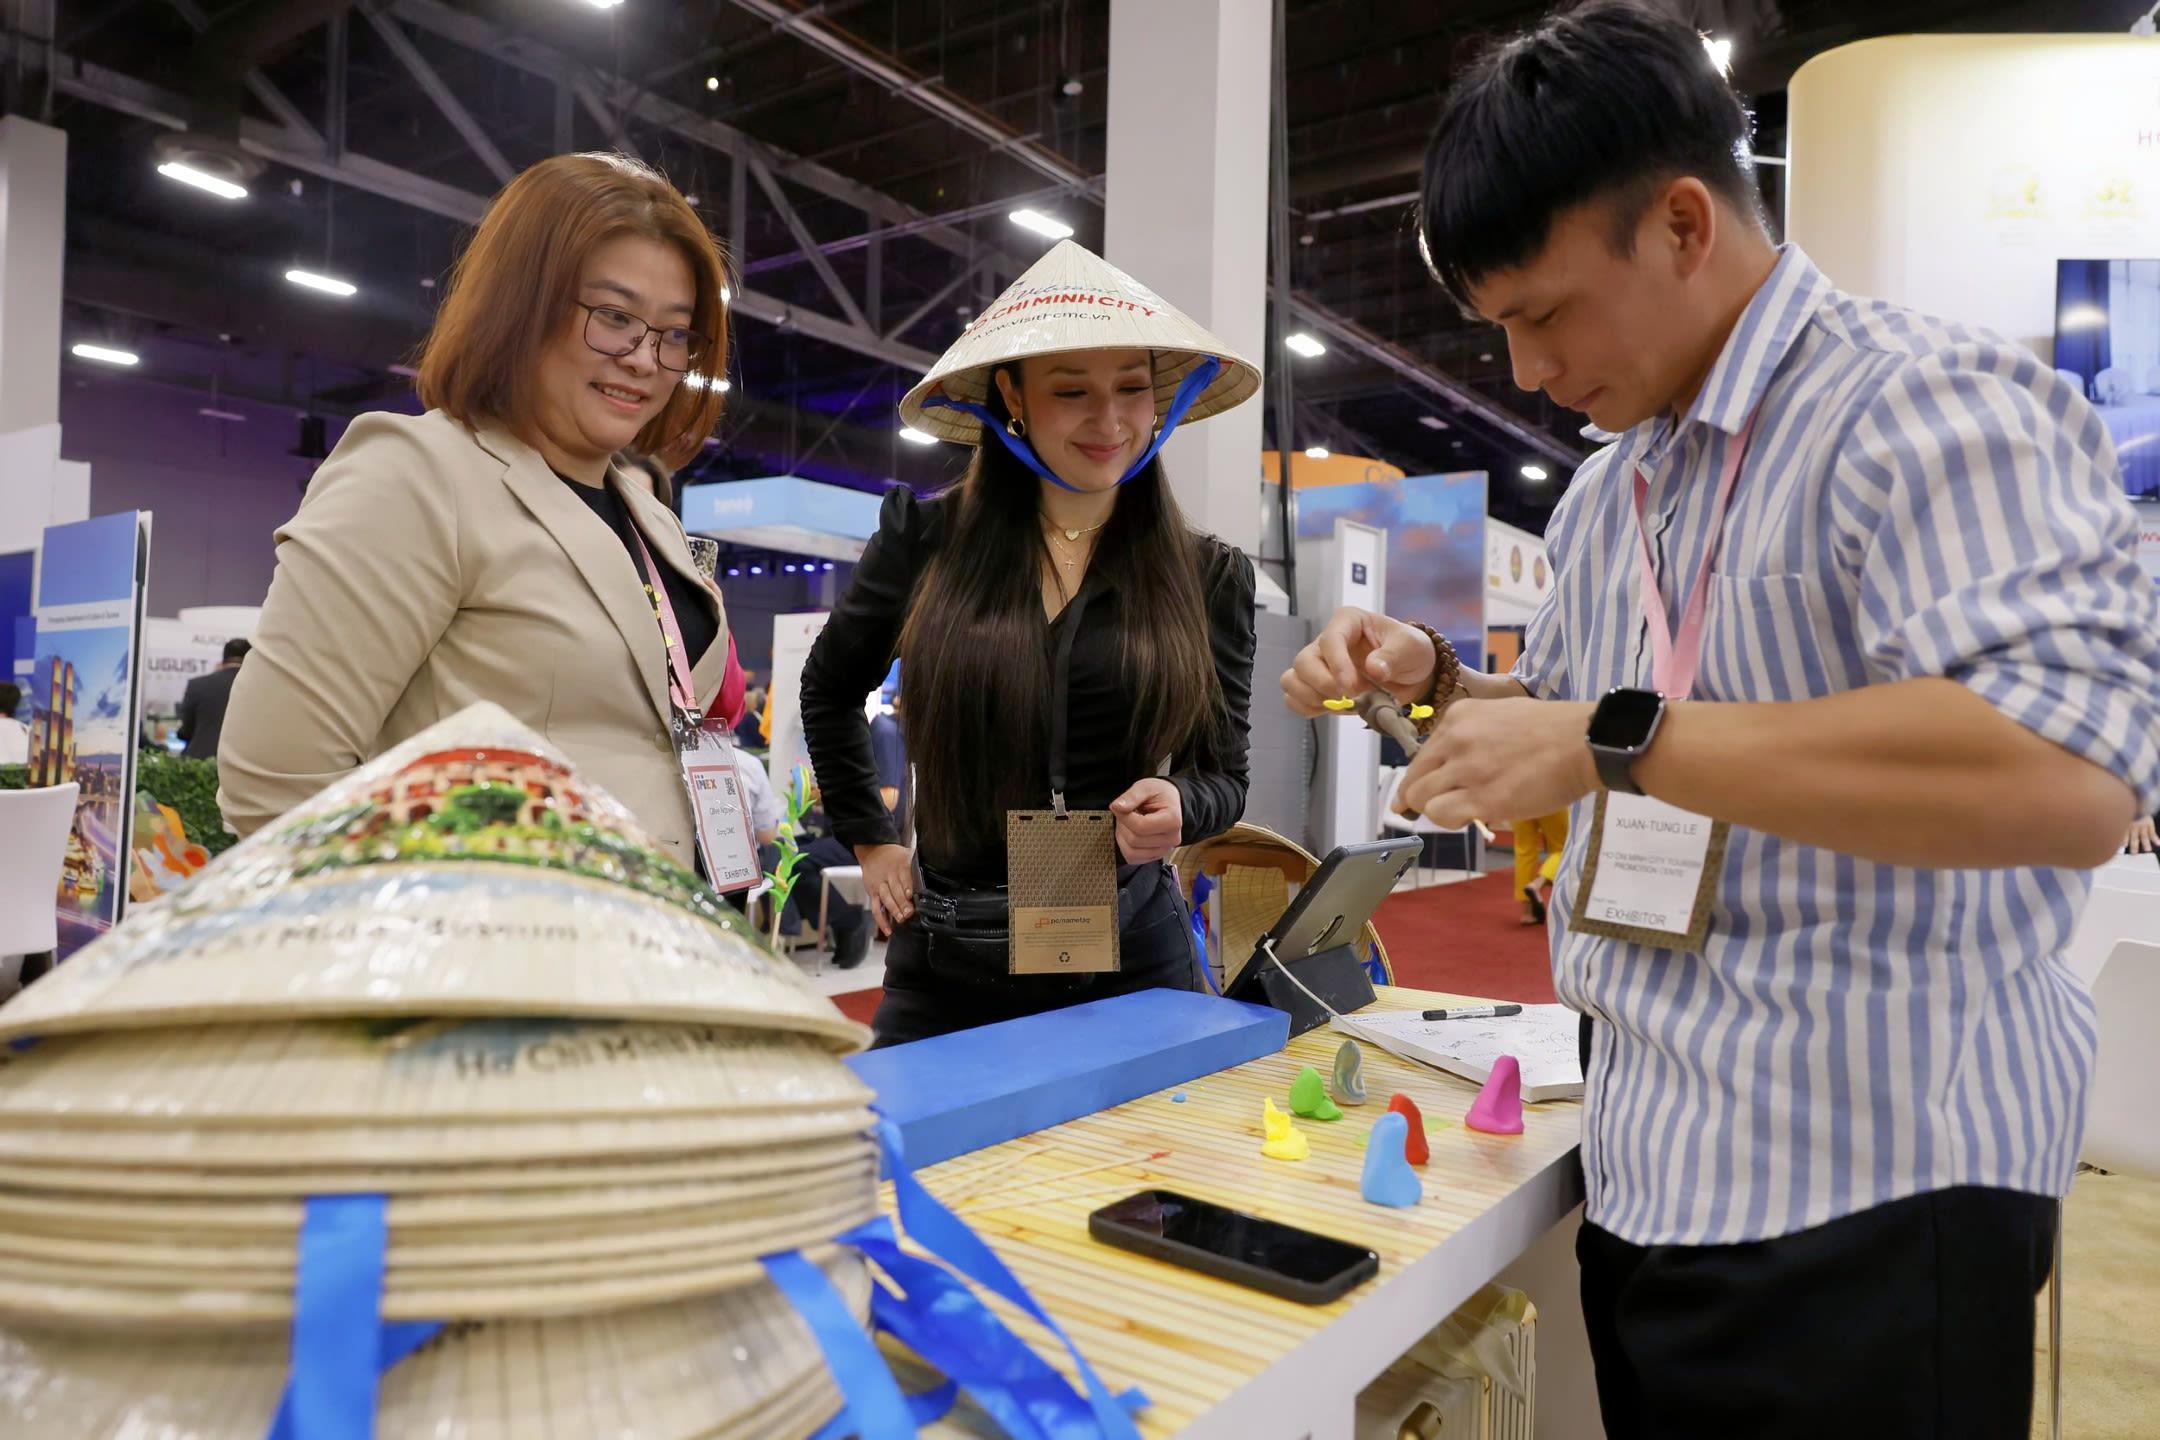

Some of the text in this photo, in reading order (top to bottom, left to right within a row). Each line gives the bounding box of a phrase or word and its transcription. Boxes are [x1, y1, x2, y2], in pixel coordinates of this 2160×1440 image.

[991, 300, 1028, 320] CHI
[1032, 293, 1095, 307] MINH
[1098, 295, 1157, 318] CITY
[147, 656, 209, 674] UGUST
[1615, 817, 1698, 836] XUAN-TUNG LE
[1605, 906, 1667, 926] EXHIBITOR
